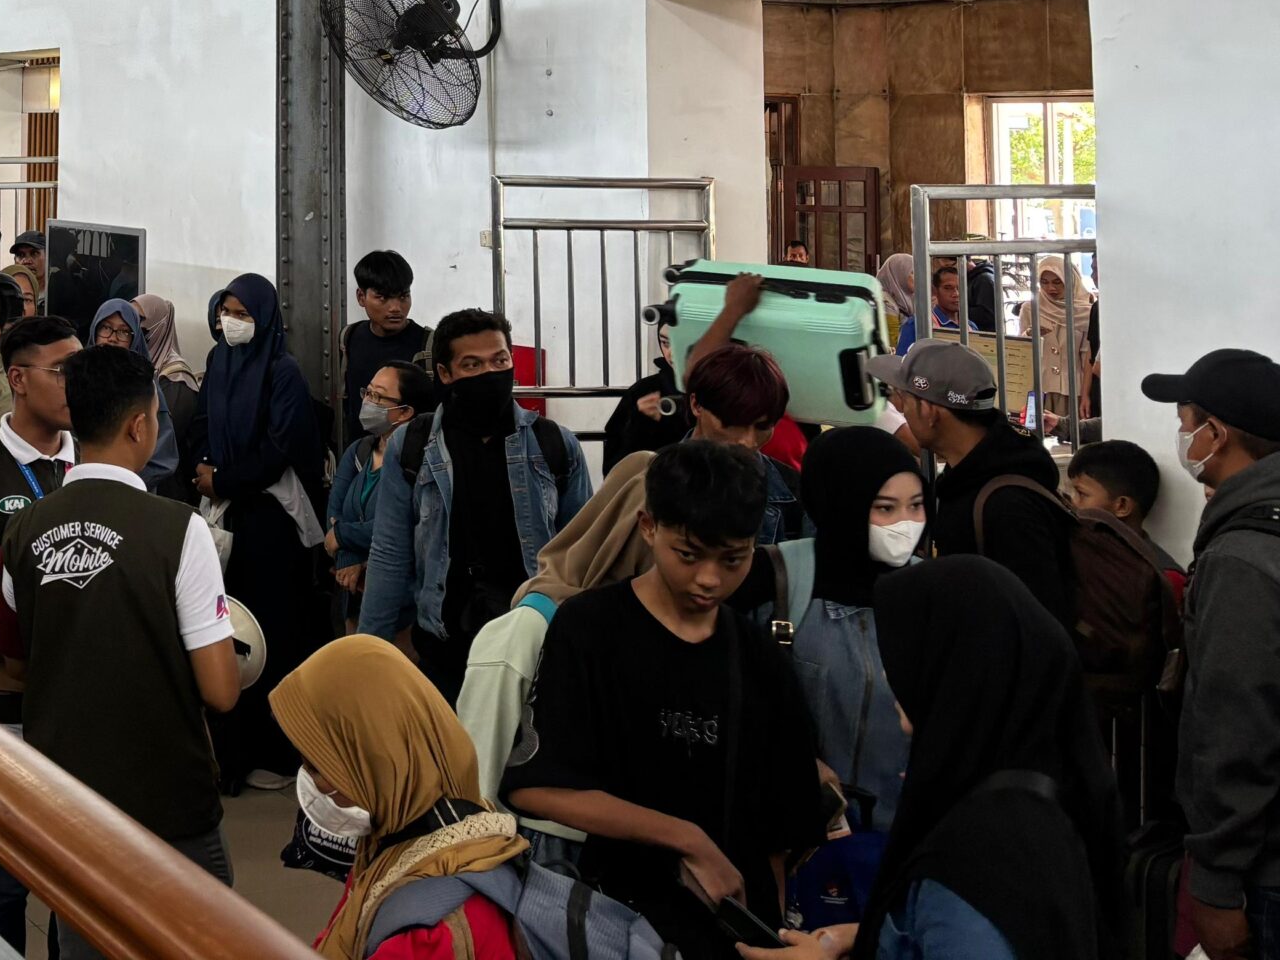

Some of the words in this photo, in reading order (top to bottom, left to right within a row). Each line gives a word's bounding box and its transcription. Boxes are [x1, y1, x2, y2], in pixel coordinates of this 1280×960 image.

[4, 498, 25, 512] KAI
[31, 521, 82, 556] CUSTOMER
[83, 521, 124, 550] SERVICE
